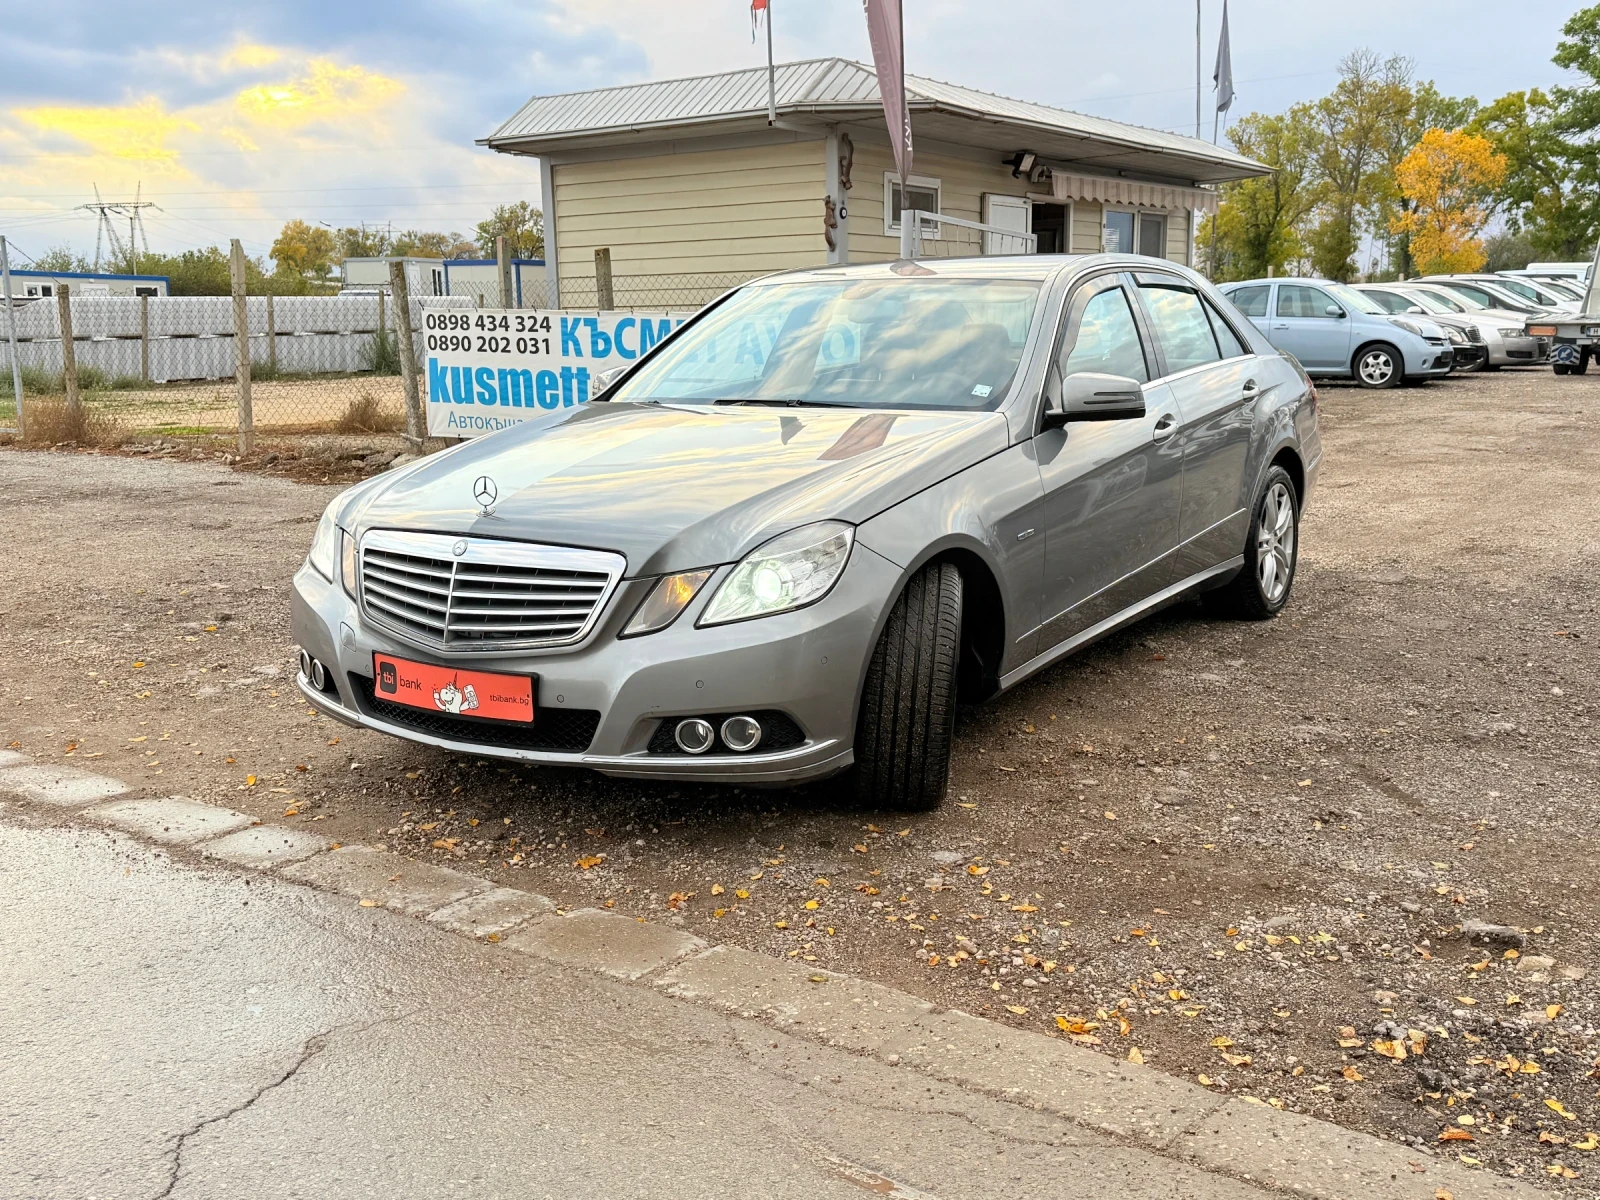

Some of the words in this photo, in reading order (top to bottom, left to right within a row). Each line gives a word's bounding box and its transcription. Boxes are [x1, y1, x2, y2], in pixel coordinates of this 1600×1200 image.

[426, 313, 471, 331] 0898
[474, 314, 510, 332] 434
[515, 315, 552, 333] 324
[427, 334, 472, 352] 0890
[476, 336, 511, 353] 202
[516, 337, 550, 355] 031
[428, 357, 591, 410] kusmett
[383, 672, 394, 684] tbi
[399, 675, 422, 691] bank
[489, 694, 530, 706] tbibank.bg
